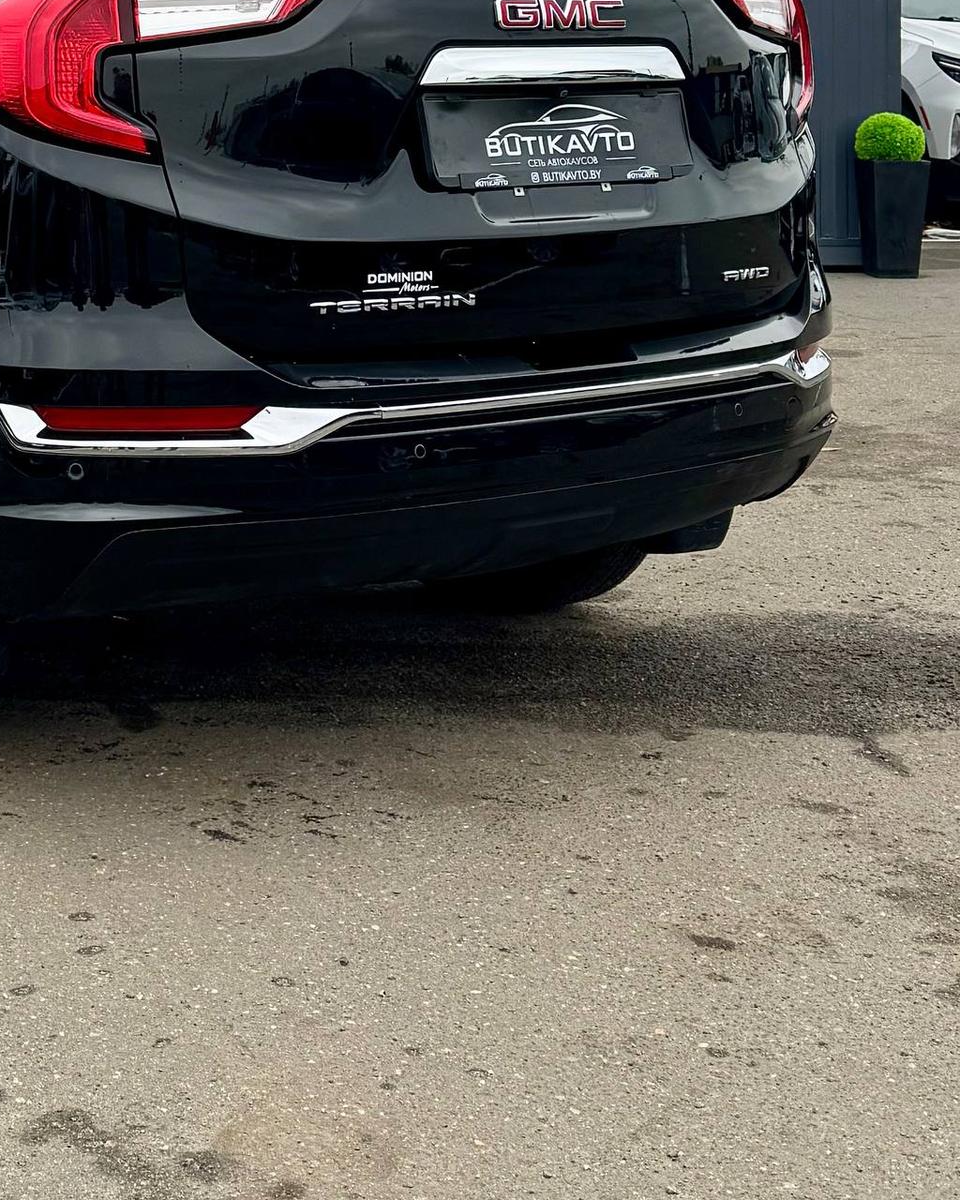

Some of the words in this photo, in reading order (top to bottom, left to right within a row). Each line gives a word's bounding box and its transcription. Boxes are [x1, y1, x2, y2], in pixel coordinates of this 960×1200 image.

[485, 131, 636, 157] BUTIKAVTO
[542, 169, 603, 183] BUTIKAVTO.BY
[367, 270, 433, 284] DOMINION
[721, 266, 770, 282] AWD
[398, 281, 430, 294] Motors
[309, 293, 477, 315] TERRAIN
